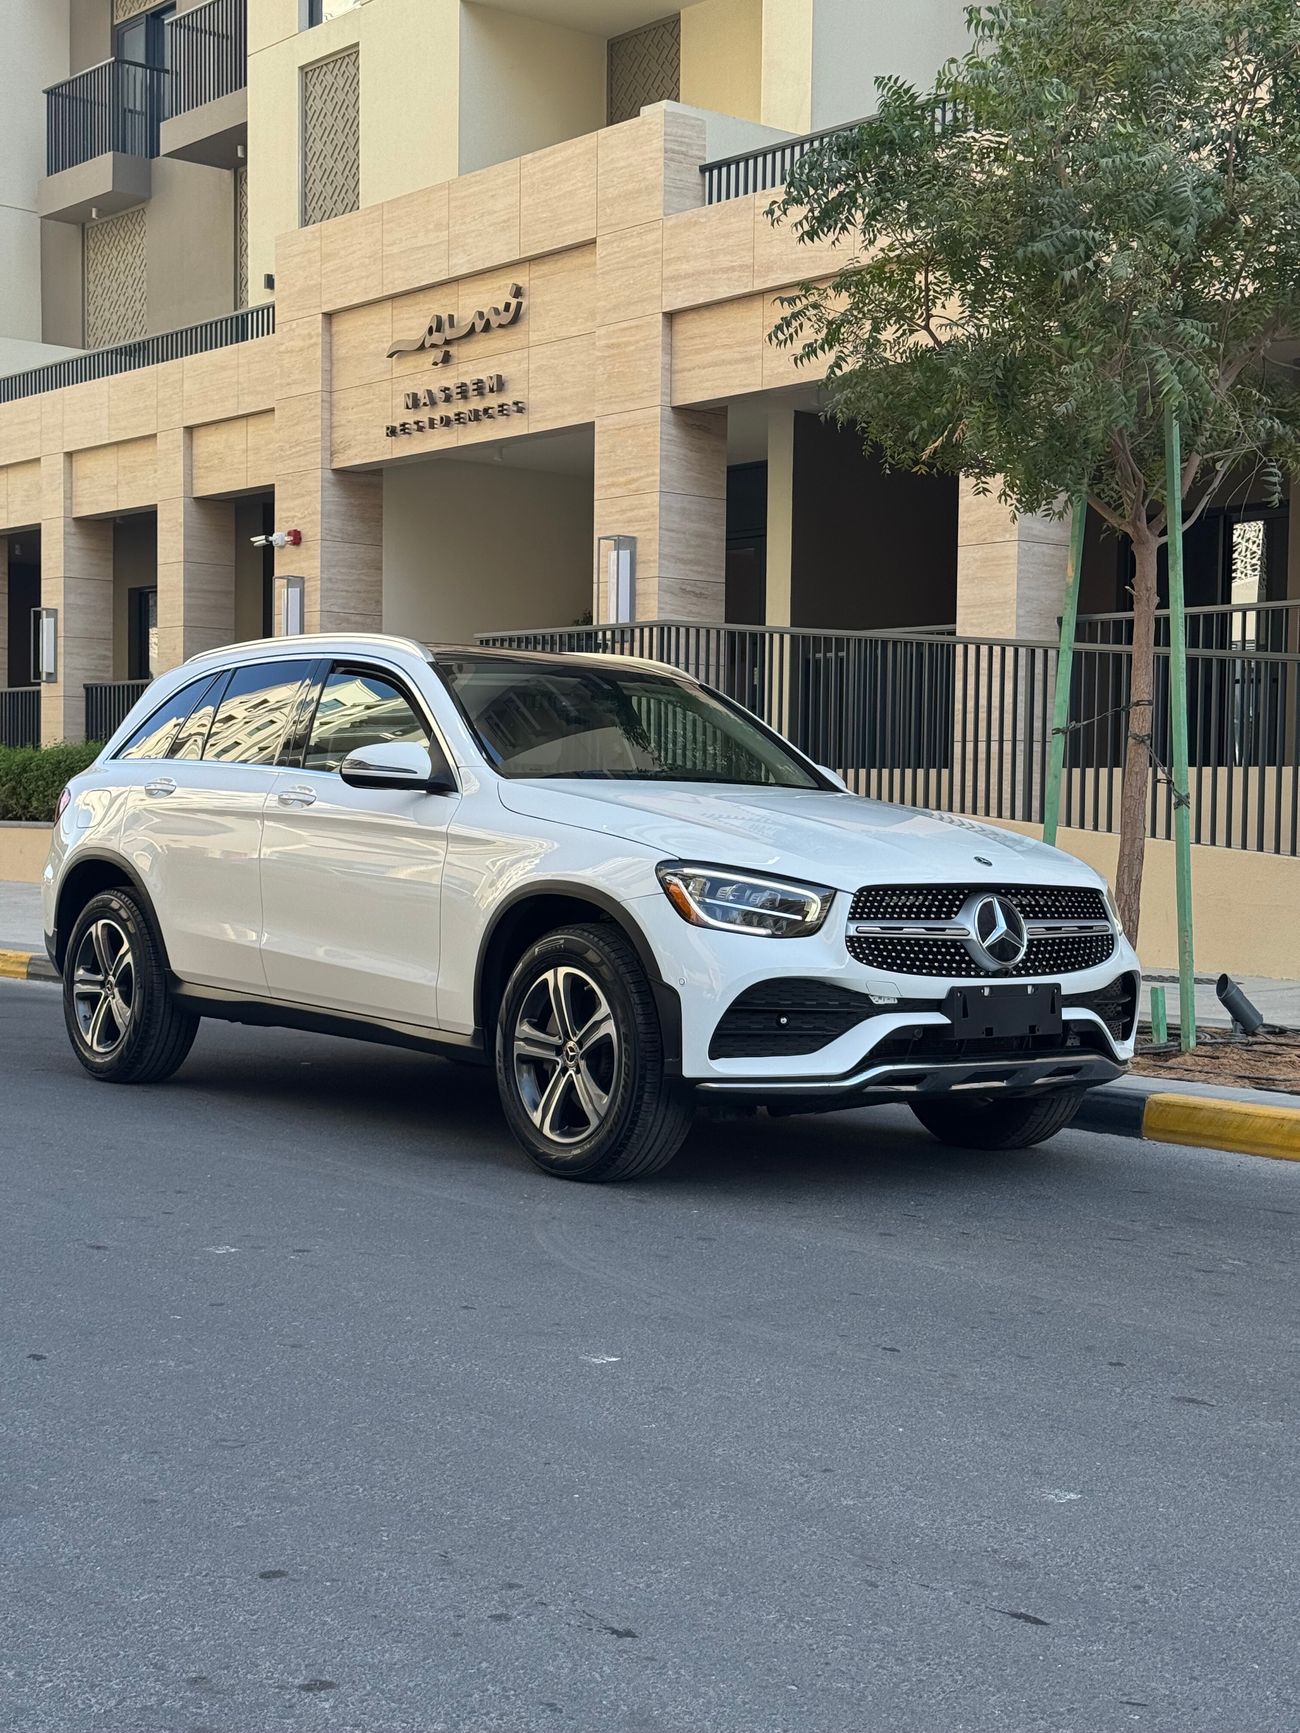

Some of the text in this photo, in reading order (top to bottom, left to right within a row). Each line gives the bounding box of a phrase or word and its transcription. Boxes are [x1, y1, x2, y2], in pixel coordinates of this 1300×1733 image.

[386, 283, 524, 366] نسيم
[403, 373, 503, 410] NASEEM
[385, 400, 526, 438] RESIDENCES
